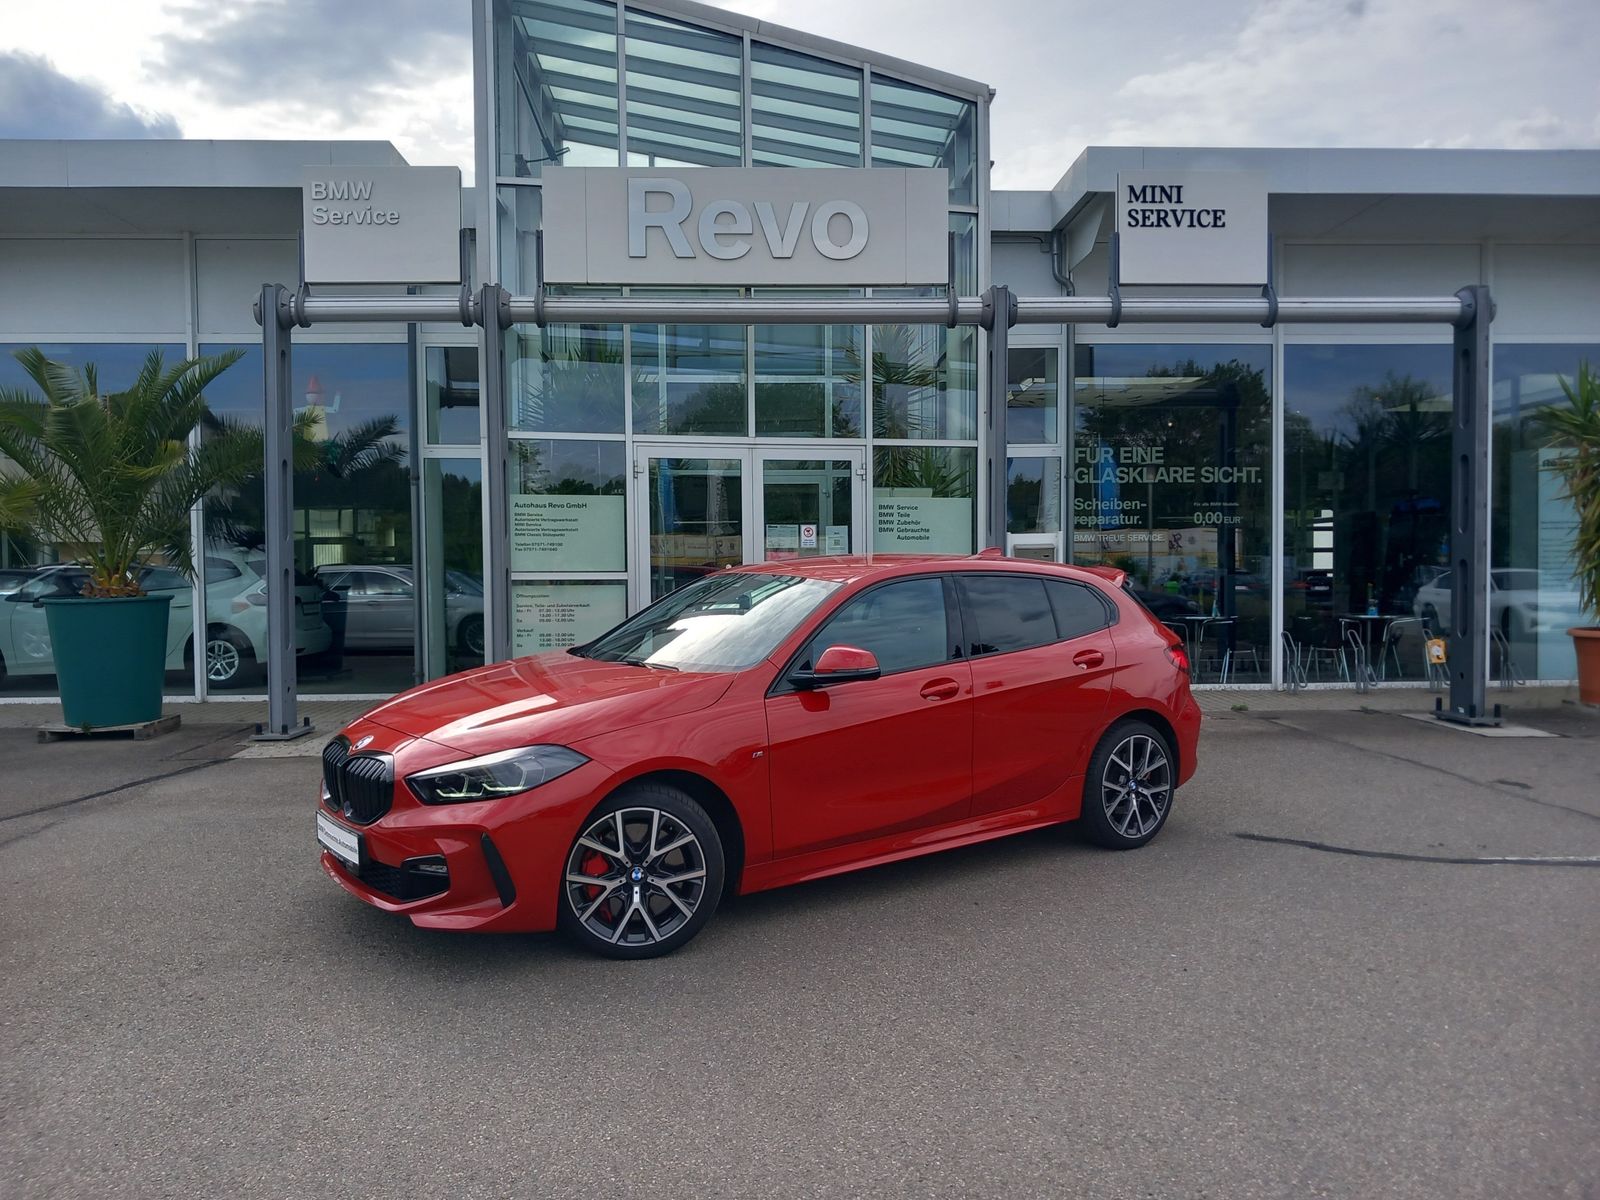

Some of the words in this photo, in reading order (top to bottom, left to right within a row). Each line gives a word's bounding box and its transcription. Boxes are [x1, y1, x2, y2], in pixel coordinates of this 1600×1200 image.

[311, 180, 374, 201] BMW
[1127, 184, 1184, 204] MINI
[312, 205, 400, 226] Service
[627, 177, 870, 260] Revo
[1127, 208, 1226, 228] SERVICE
[1074, 443, 1114, 464] FÜR
[1120, 446, 1165, 464] EINE
[1074, 466, 1196, 484] GLASKLARE
[1200, 466, 1262, 484] SICHT.
[1074, 497, 1147, 511] Scheiben-
[1074, 514, 1142, 527] reparatur.
[1194, 511, 1223, 526] 0,00
[1073, 533, 1096, 542] BMW
[1098, 533, 1126, 542] TREUE
